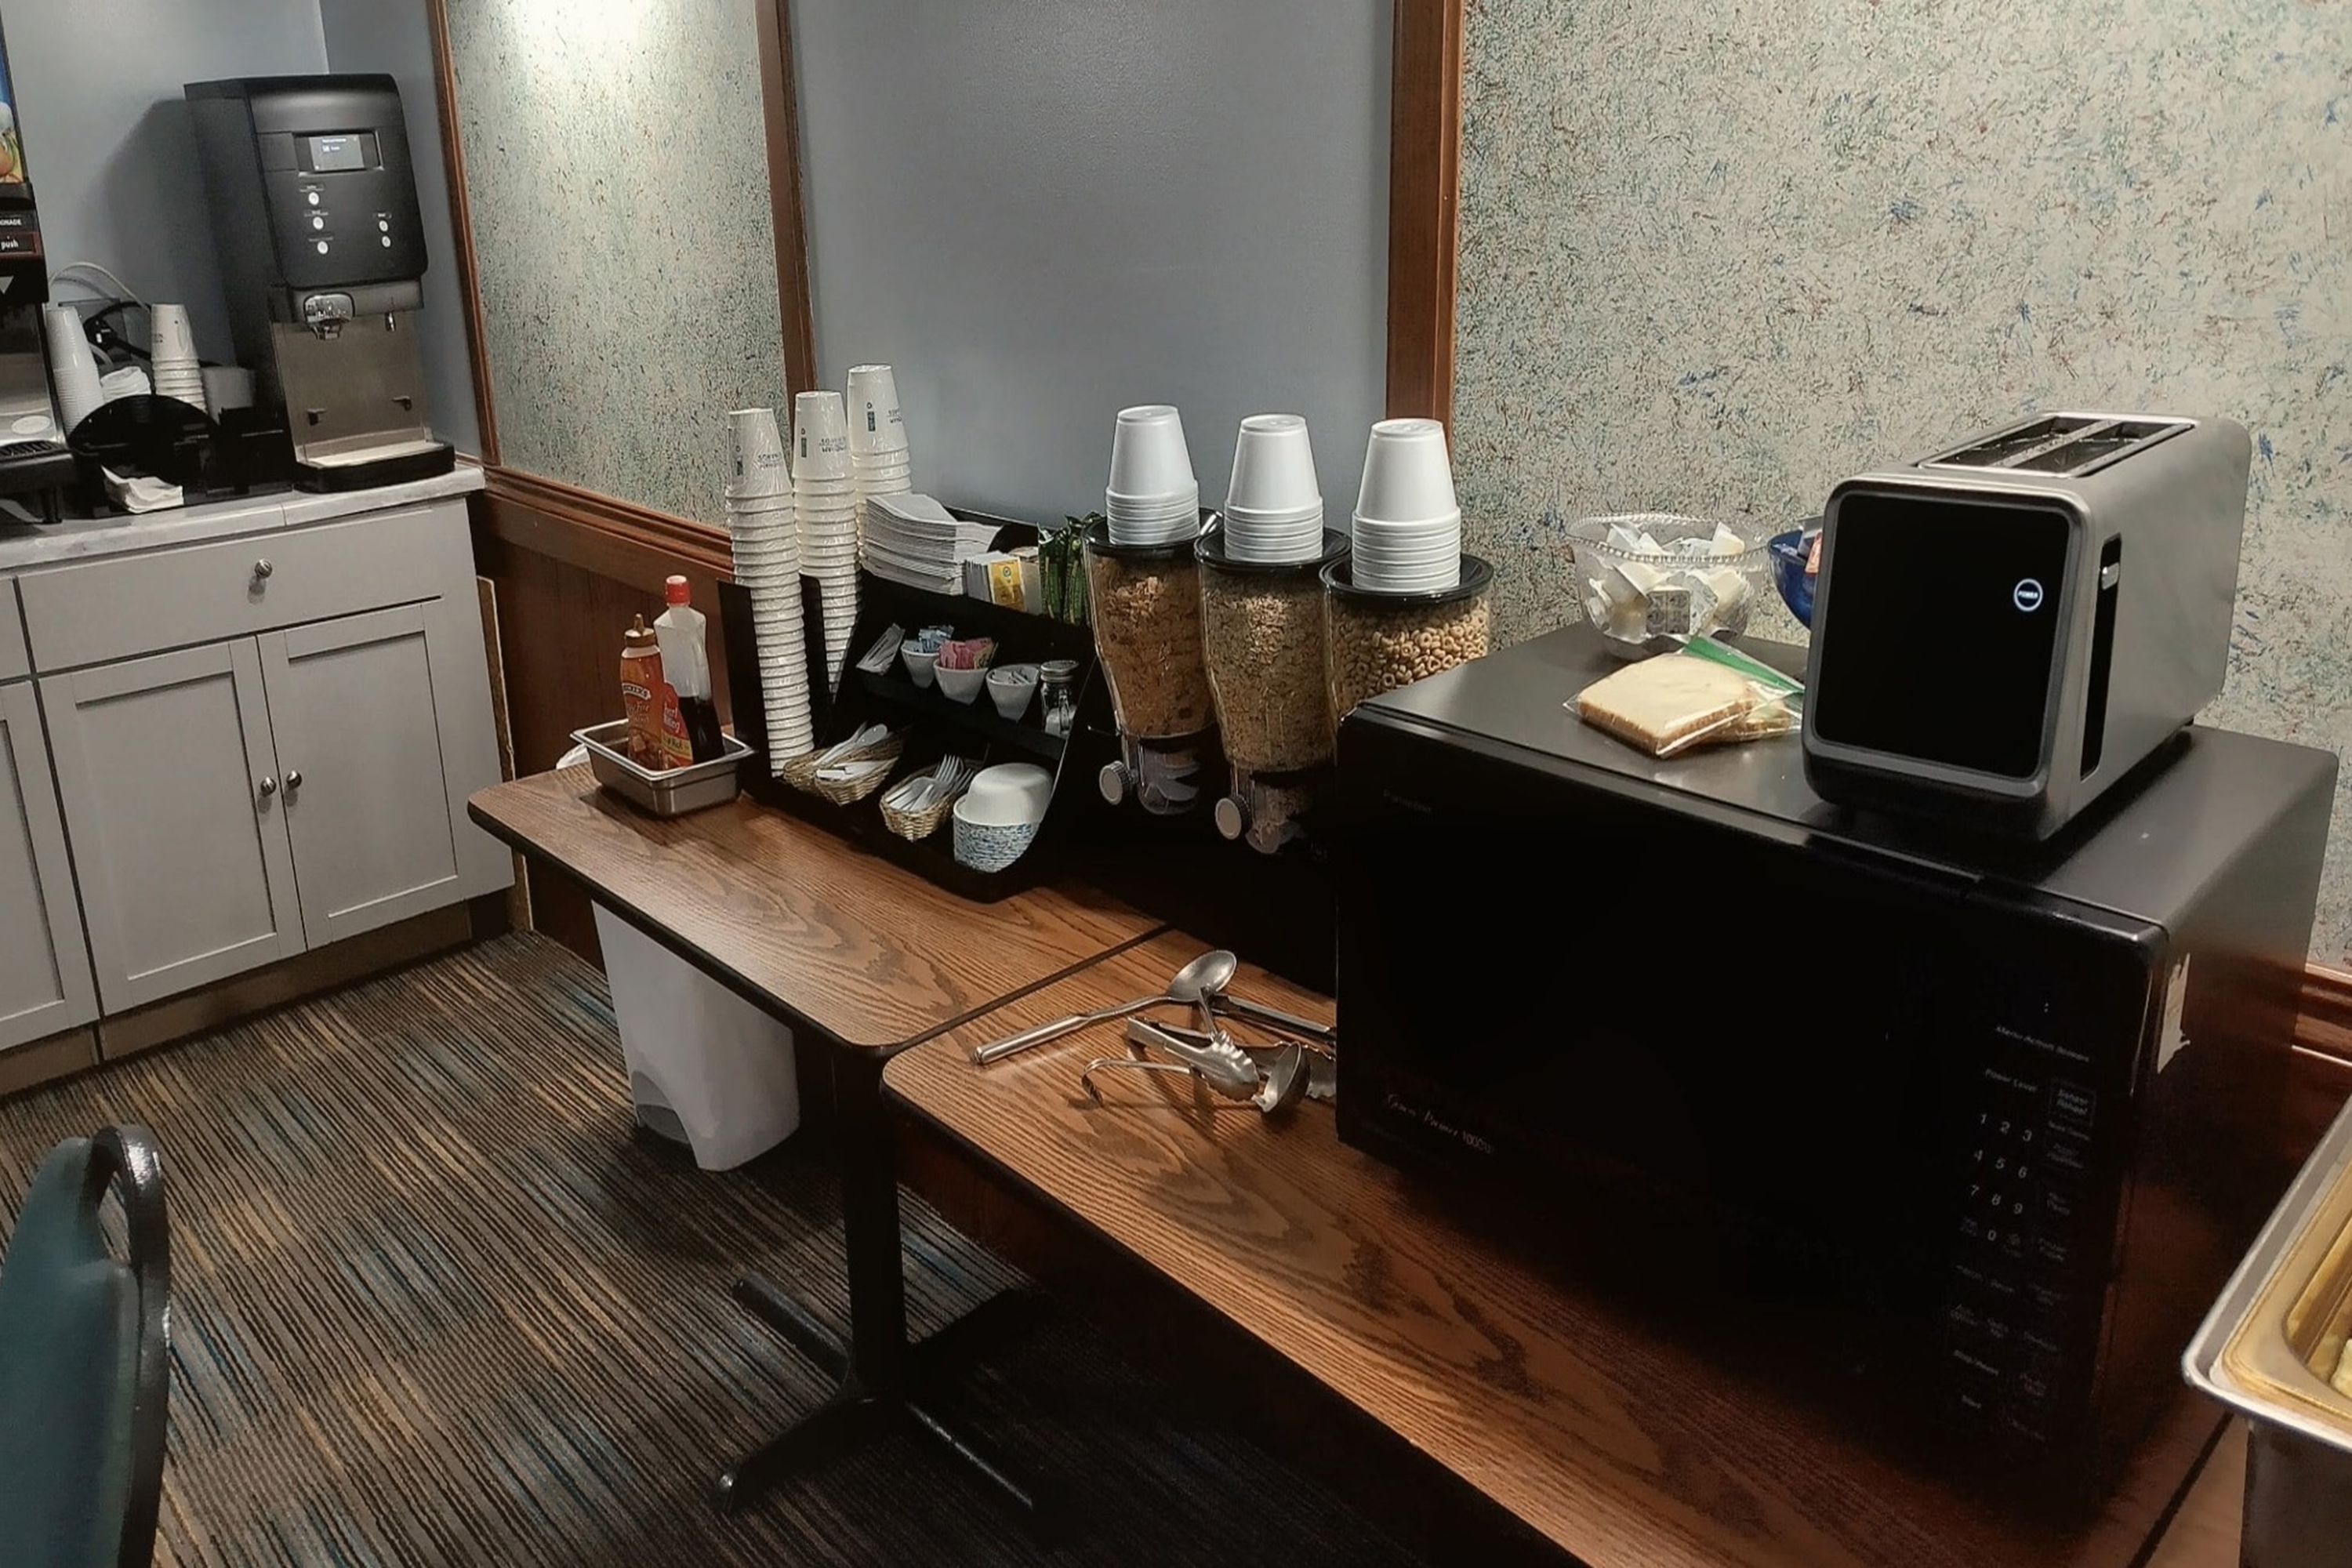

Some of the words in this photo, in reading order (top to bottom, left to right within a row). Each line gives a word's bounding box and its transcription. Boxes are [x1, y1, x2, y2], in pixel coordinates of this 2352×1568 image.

[1, 239, 19, 250] push
[1980, 1112, 1987, 1125] 1
[2000, 1120, 2011, 1134] 2
[2022, 1129, 2033, 1142] 3
[1973, 1149, 1984, 1163] 4
[1995, 1157, 2005, 1170] 5
[2018, 1166, 2028, 1178] 6
[1970, 1184, 1980, 1197] 7
[1991, 1193, 2002, 1206] 8
[2013, 1202, 2023, 1214] 9
[1987, 1229, 1997, 1242] 0
